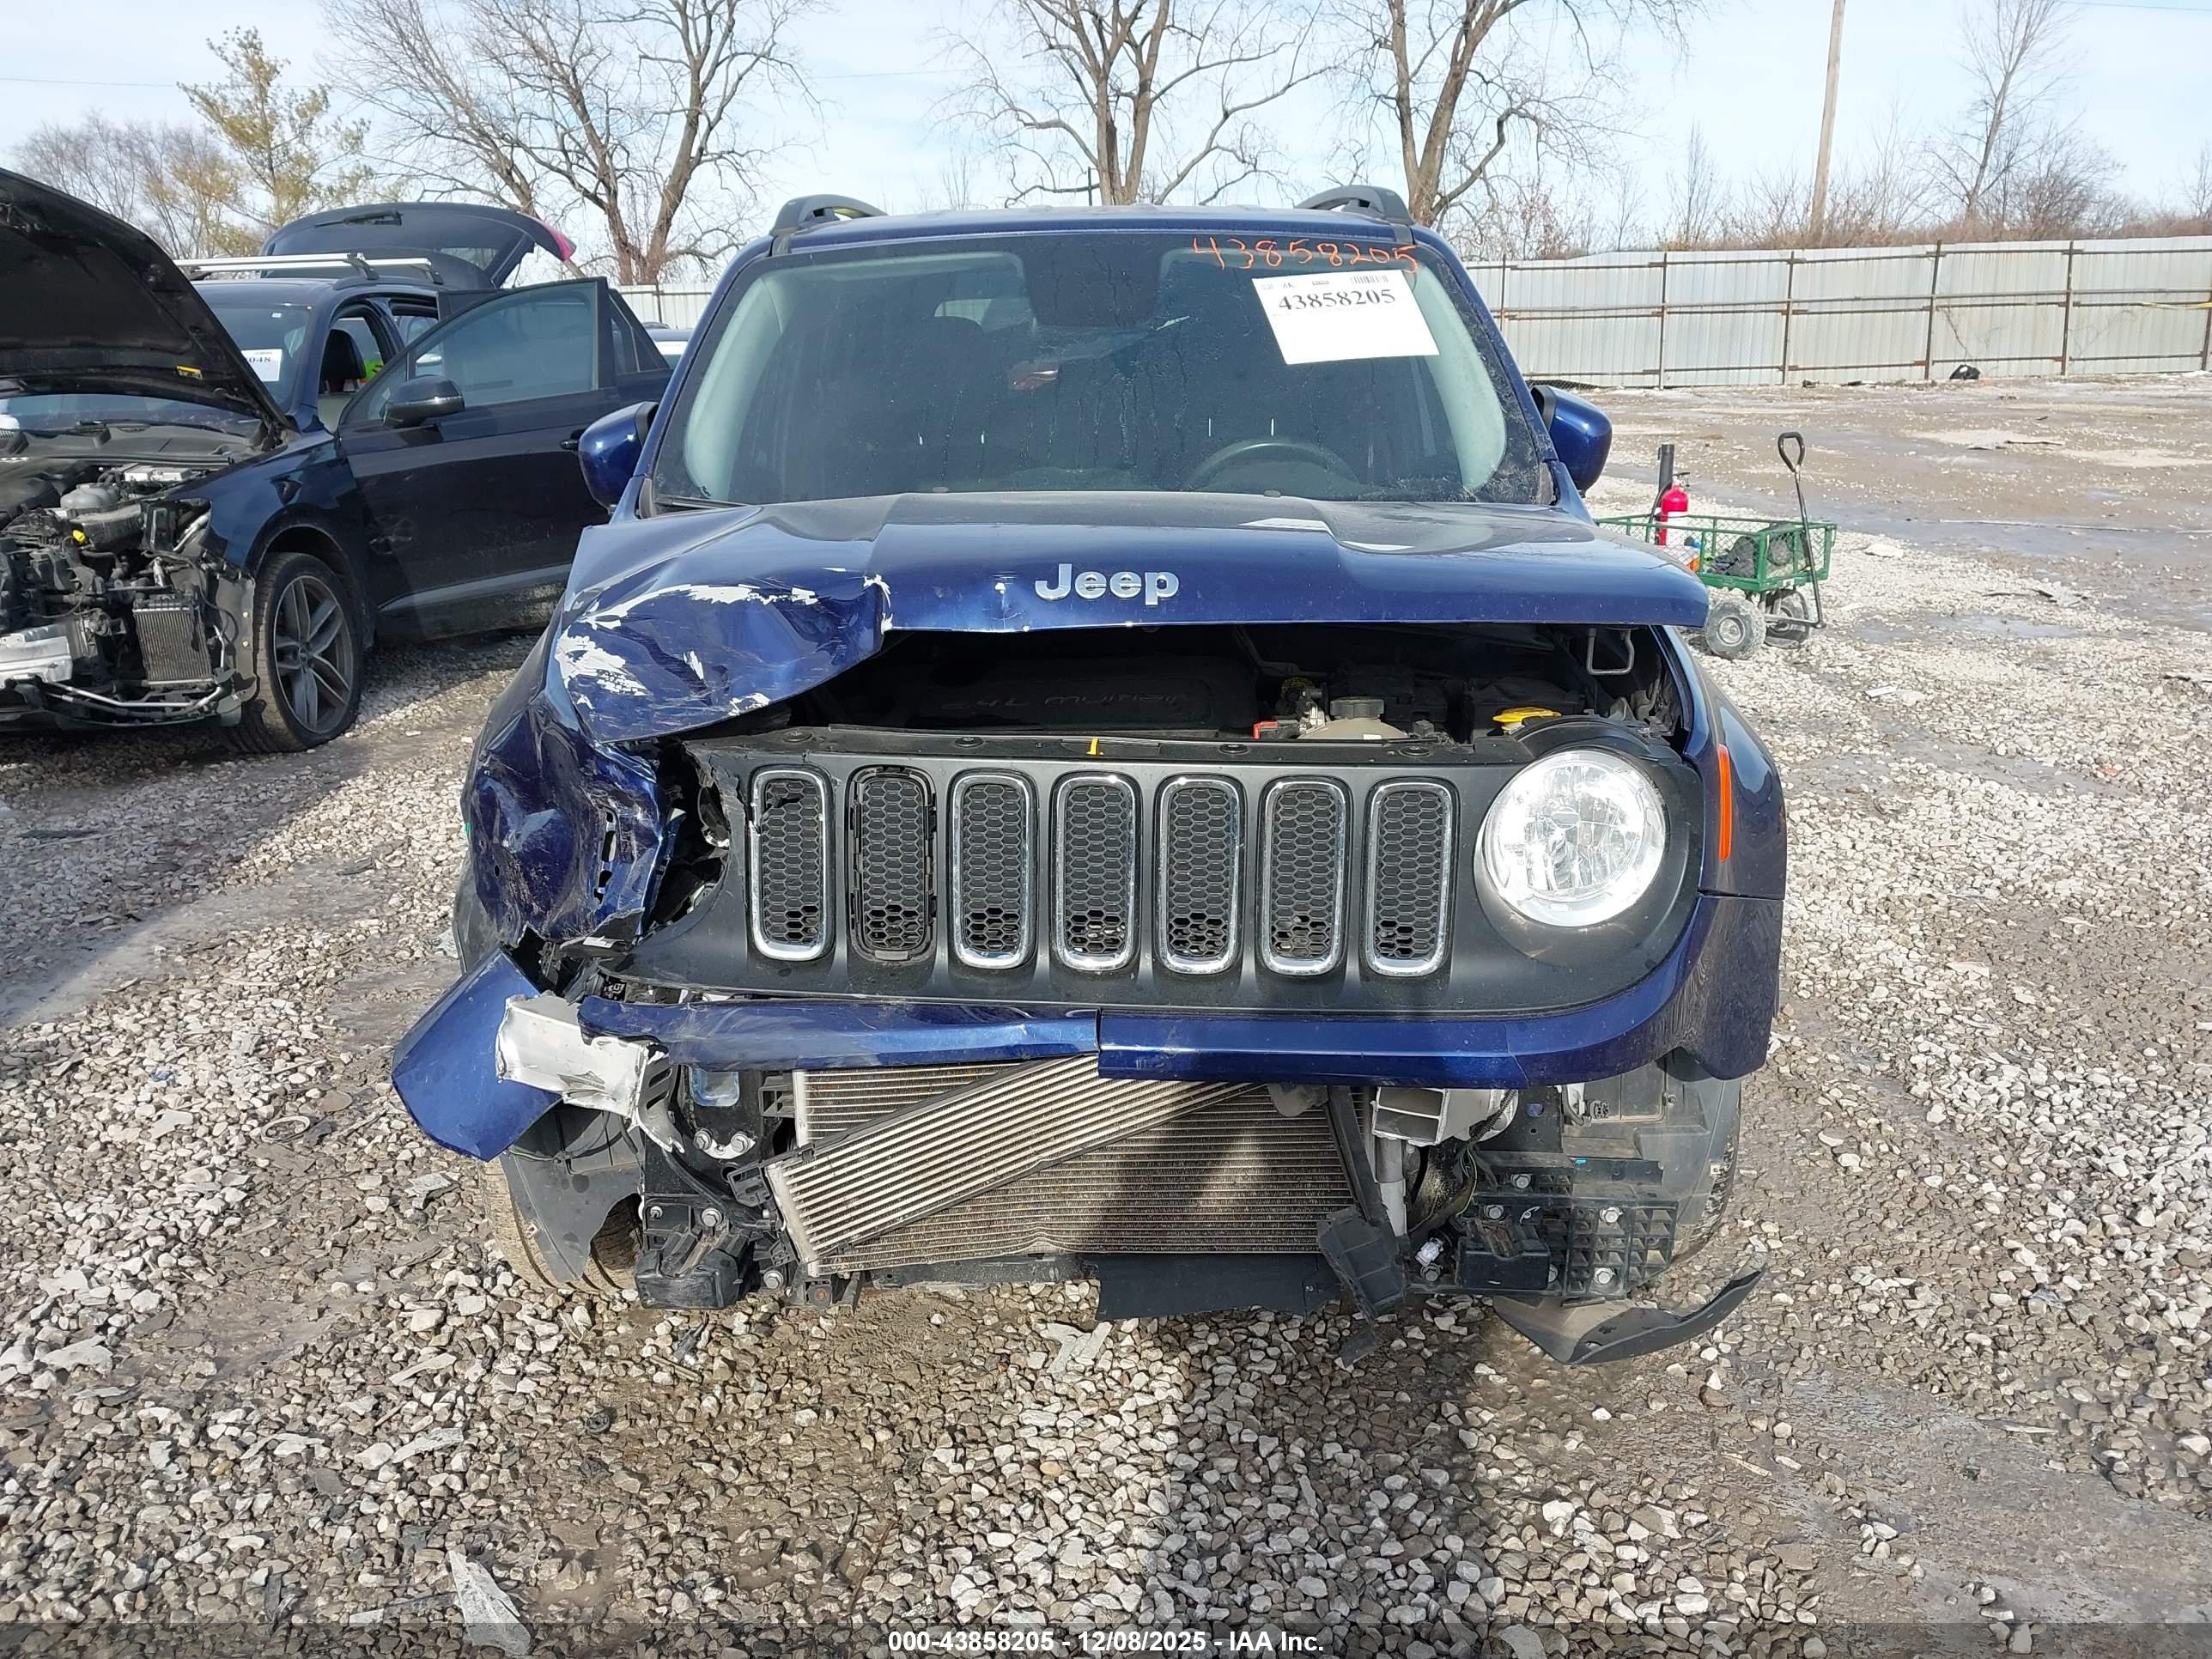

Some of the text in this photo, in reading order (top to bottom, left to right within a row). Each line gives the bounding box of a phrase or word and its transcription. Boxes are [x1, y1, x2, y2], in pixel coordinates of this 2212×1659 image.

[1193, 237, 1419, 274] 43858205
[1279, 289, 1395, 310] 43858205
[1035, 563, 1180, 606] Jeep
